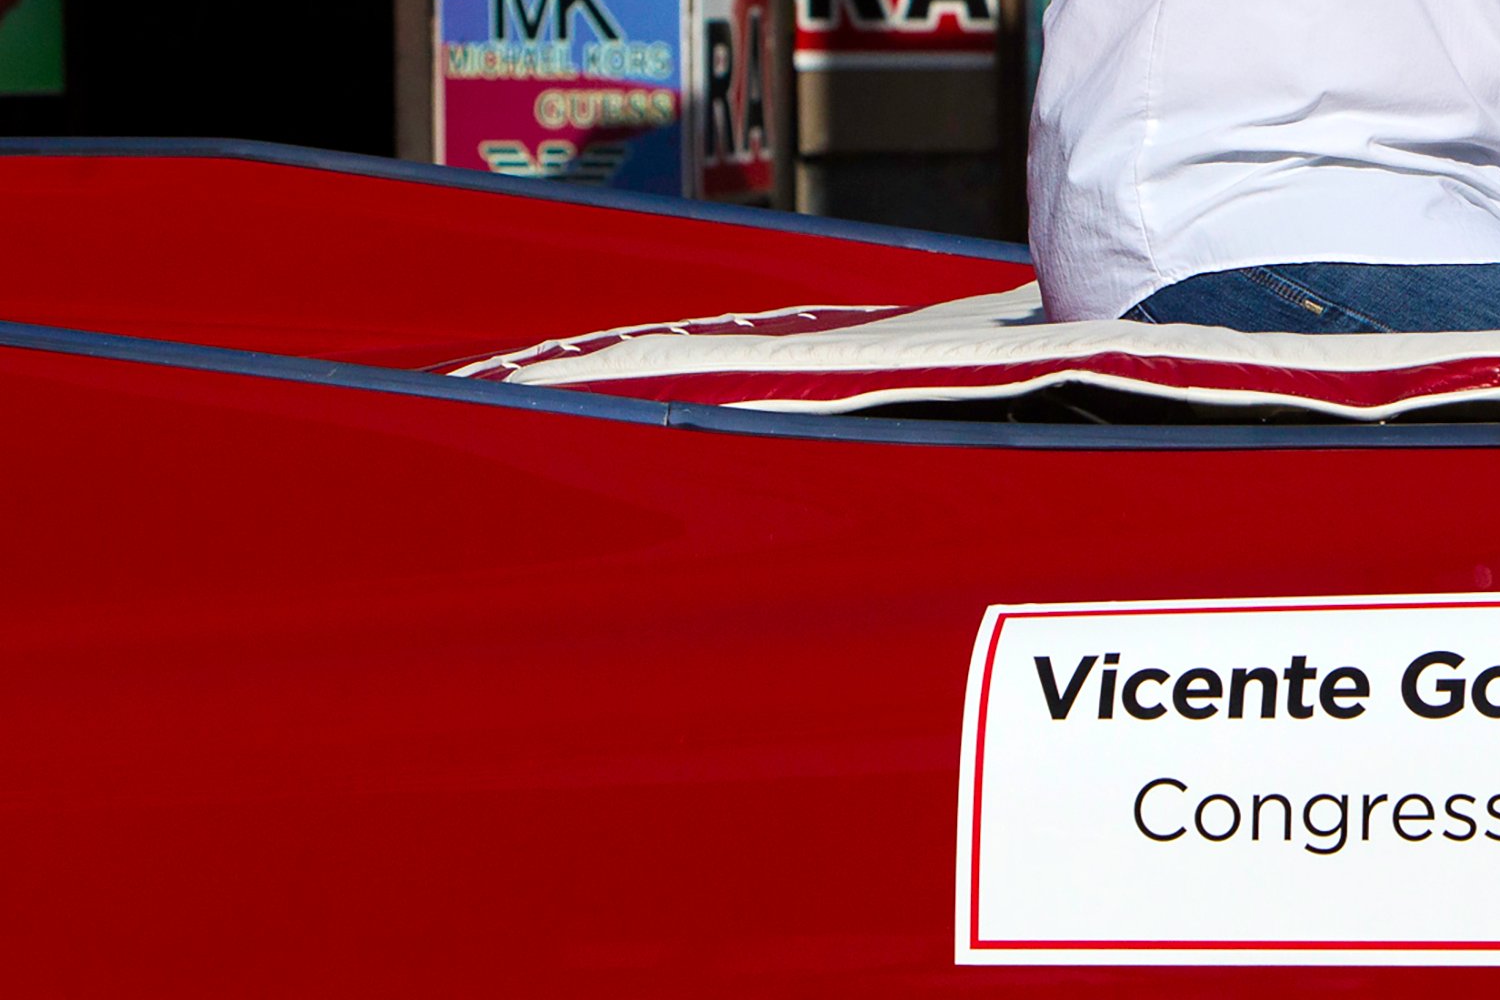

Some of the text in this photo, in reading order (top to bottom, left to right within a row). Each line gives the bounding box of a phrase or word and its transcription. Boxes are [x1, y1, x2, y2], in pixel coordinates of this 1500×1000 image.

[447, 43, 673, 78] MICHAEL KORS
[536, 91, 676, 128] GUESS
[1034, 653, 1369, 719] Vicente
